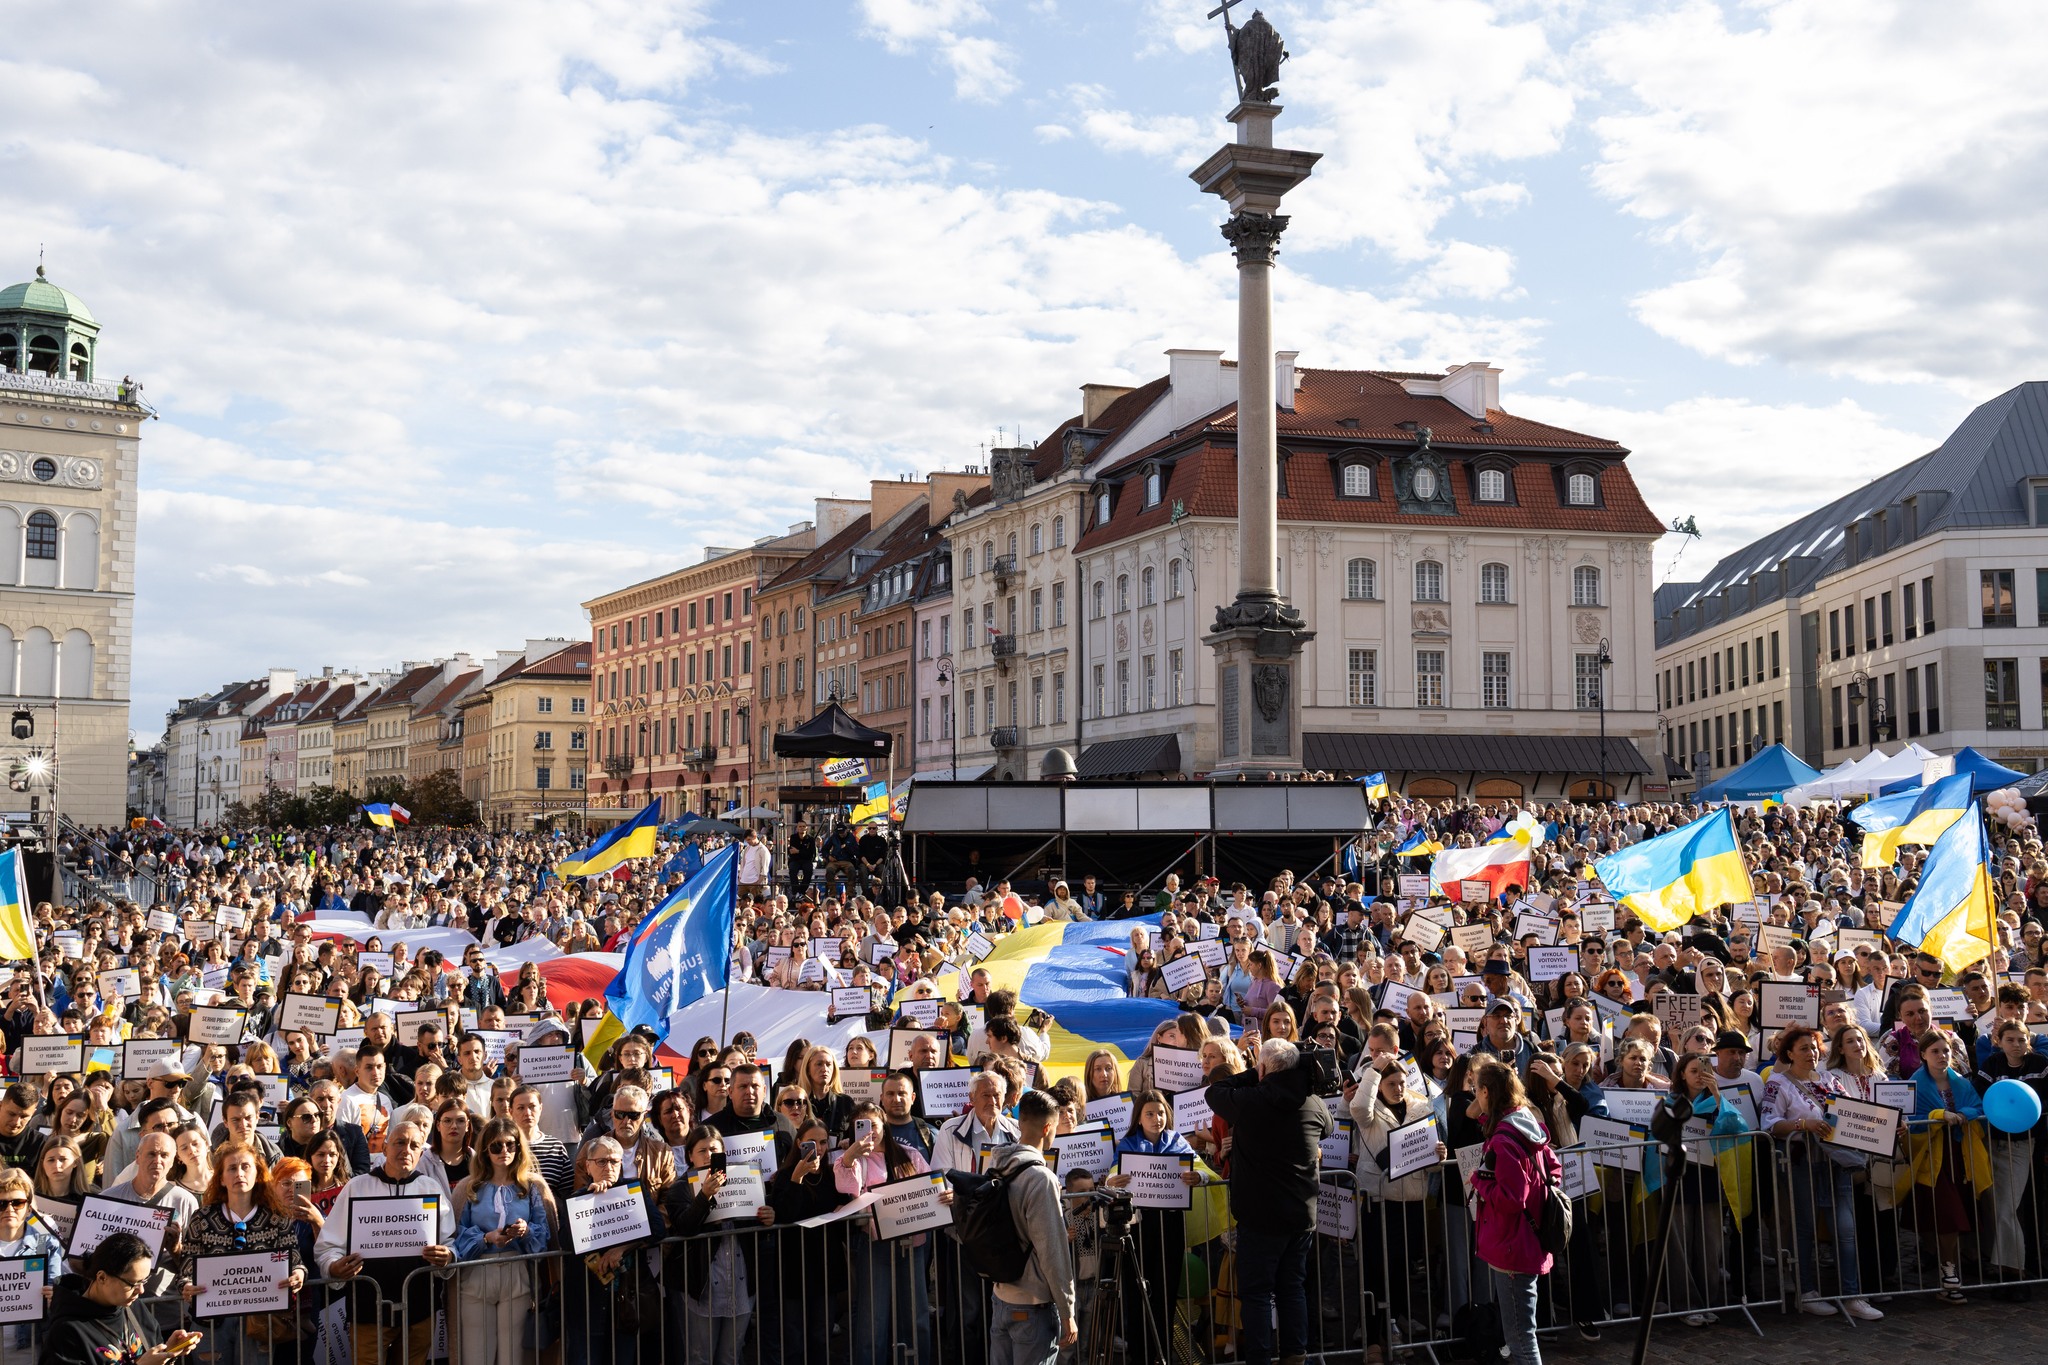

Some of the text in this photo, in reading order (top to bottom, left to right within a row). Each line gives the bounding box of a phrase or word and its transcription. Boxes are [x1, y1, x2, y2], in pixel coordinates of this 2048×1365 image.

[1656, 996, 1696, 1011] FREE
[1670, 1011, 1684, 1021] 57
[1155, 1057, 1202, 1069] ANDRII YUREVYC
[1105, 1106, 1127, 1116] FOMIN
[1179, 1100, 1205, 1110] BOHDAN
[1838, 1109, 1887, 1126] OLEH OKHRIMENKO
[1853, 1123, 1866, 1131] YEARS
[1404, 1127, 1426, 1140] DMYTRO
[1594, 1130, 1630, 1142] ALBINA BITSMAN
[1840, 1131, 1854, 1139] KILLED
[1860, 1135, 1879, 1144] RUSSIANS
[1067, 1141, 1096, 1150] MAKSYM
[1401, 1134, 1429, 1149] MURAVIOV
[726, 1145, 766, 1157] URII STRUK
[1061, 1148, 1104, 1160] OKHTYRSKYI
[1407, 1148, 1420, 1156] YEARS
[1415, 1151, 1435, 1163] RUSSIANS
[1130, 1171, 1182, 1180] MYKHALONOK
[882, 1187, 938, 1206] MAKSYM BOHUTSKYI
[1318, 1191, 1353, 1203] KSANDRA
[575, 1198, 636, 1220] STEPAN VIENTS
[906, 1203, 920, 1212] YEARS
[85, 1210, 161, 1230] CALLUM TINDALL
[358, 1213, 428, 1224] YURII BORSHCH
[595, 1218, 615, 1228] YEARS
[616, 1214, 629, 1222] OLD
[896, 1217, 910, 1226] KILLED
[916, 1211, 936, 1221] RUSSIANS
[101, 1223, 139, 1236] DRAPER
[581, 1233, 602, 1243] KILLED
[611, 1223, 642, 1236] RUSSIANS
[395, 1240, 428, 1248] RUSSIANS
[223, 1265, 262, 1277] JORDAN
[212, 1275, 271, 1286] MCLACHLAN
[218, 1288, 227, 1296] 26
[228, 1286, 250, 1294] YEARS
[1, 1304, 33, 1312] USSIANS
[206, 1300, 232, 1308] KILLED
[243, 1296, 279, 1305] RUSSIANS
